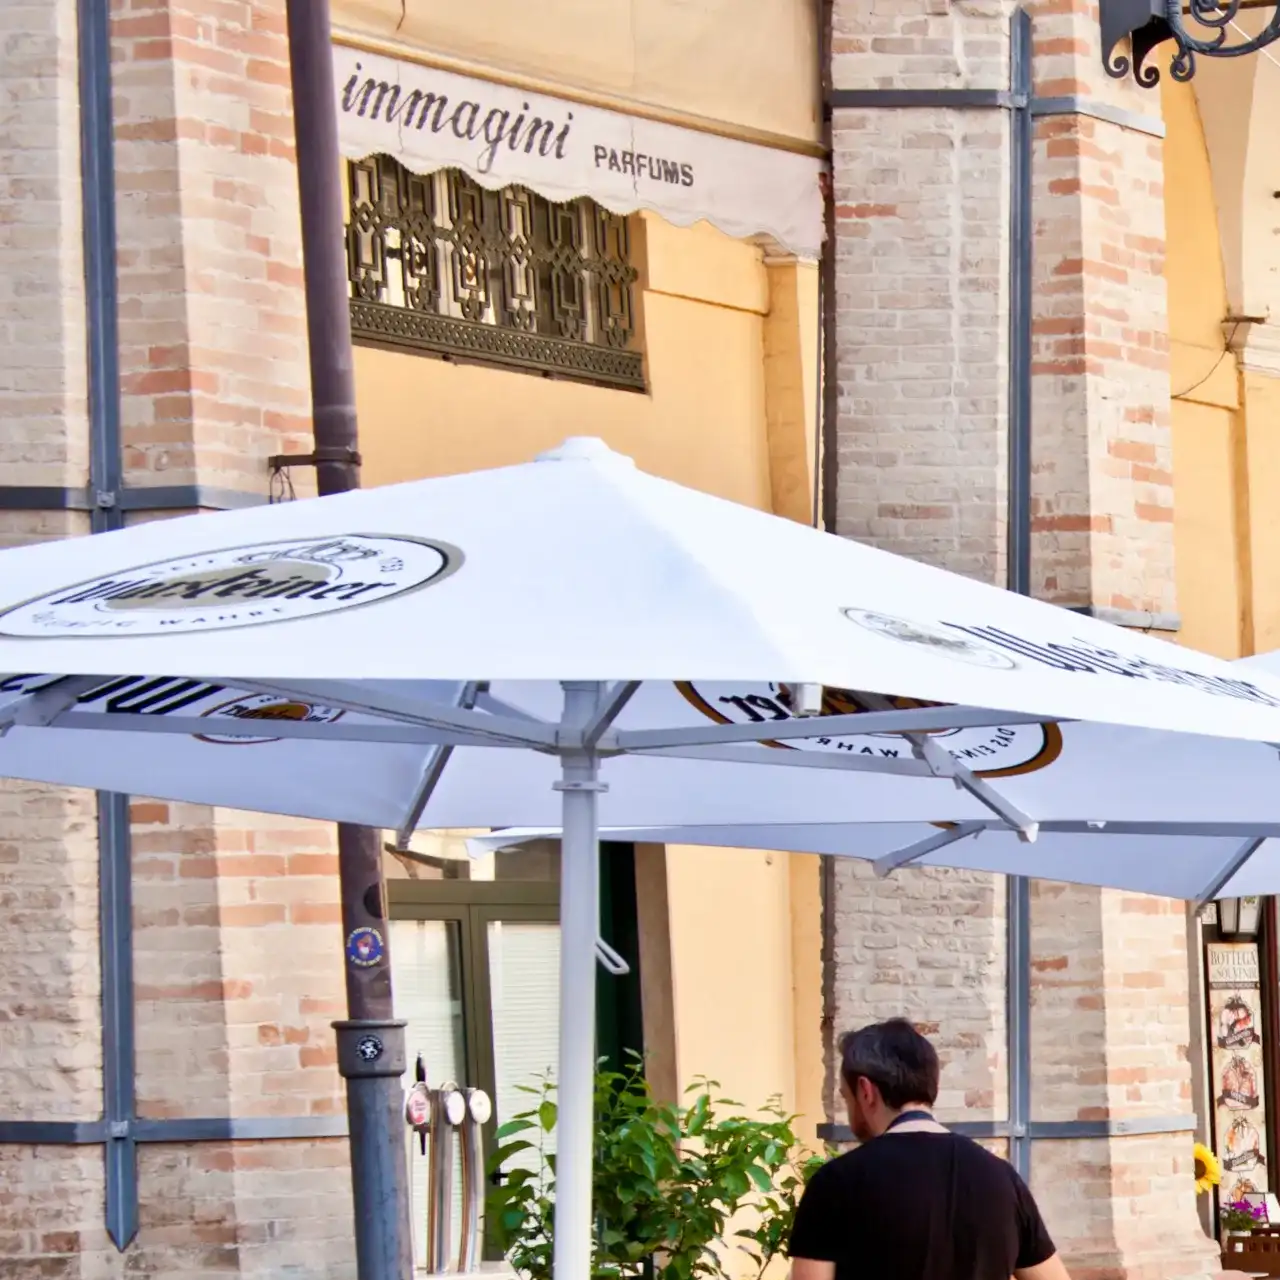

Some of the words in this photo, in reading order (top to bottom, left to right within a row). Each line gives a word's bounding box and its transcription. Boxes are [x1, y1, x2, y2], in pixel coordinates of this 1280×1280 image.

[341, 62, 574, 175] immagini
[594, 144, 695, 188] PARFUMS
[1210, 950, 1257, 966] BOTTEGA
